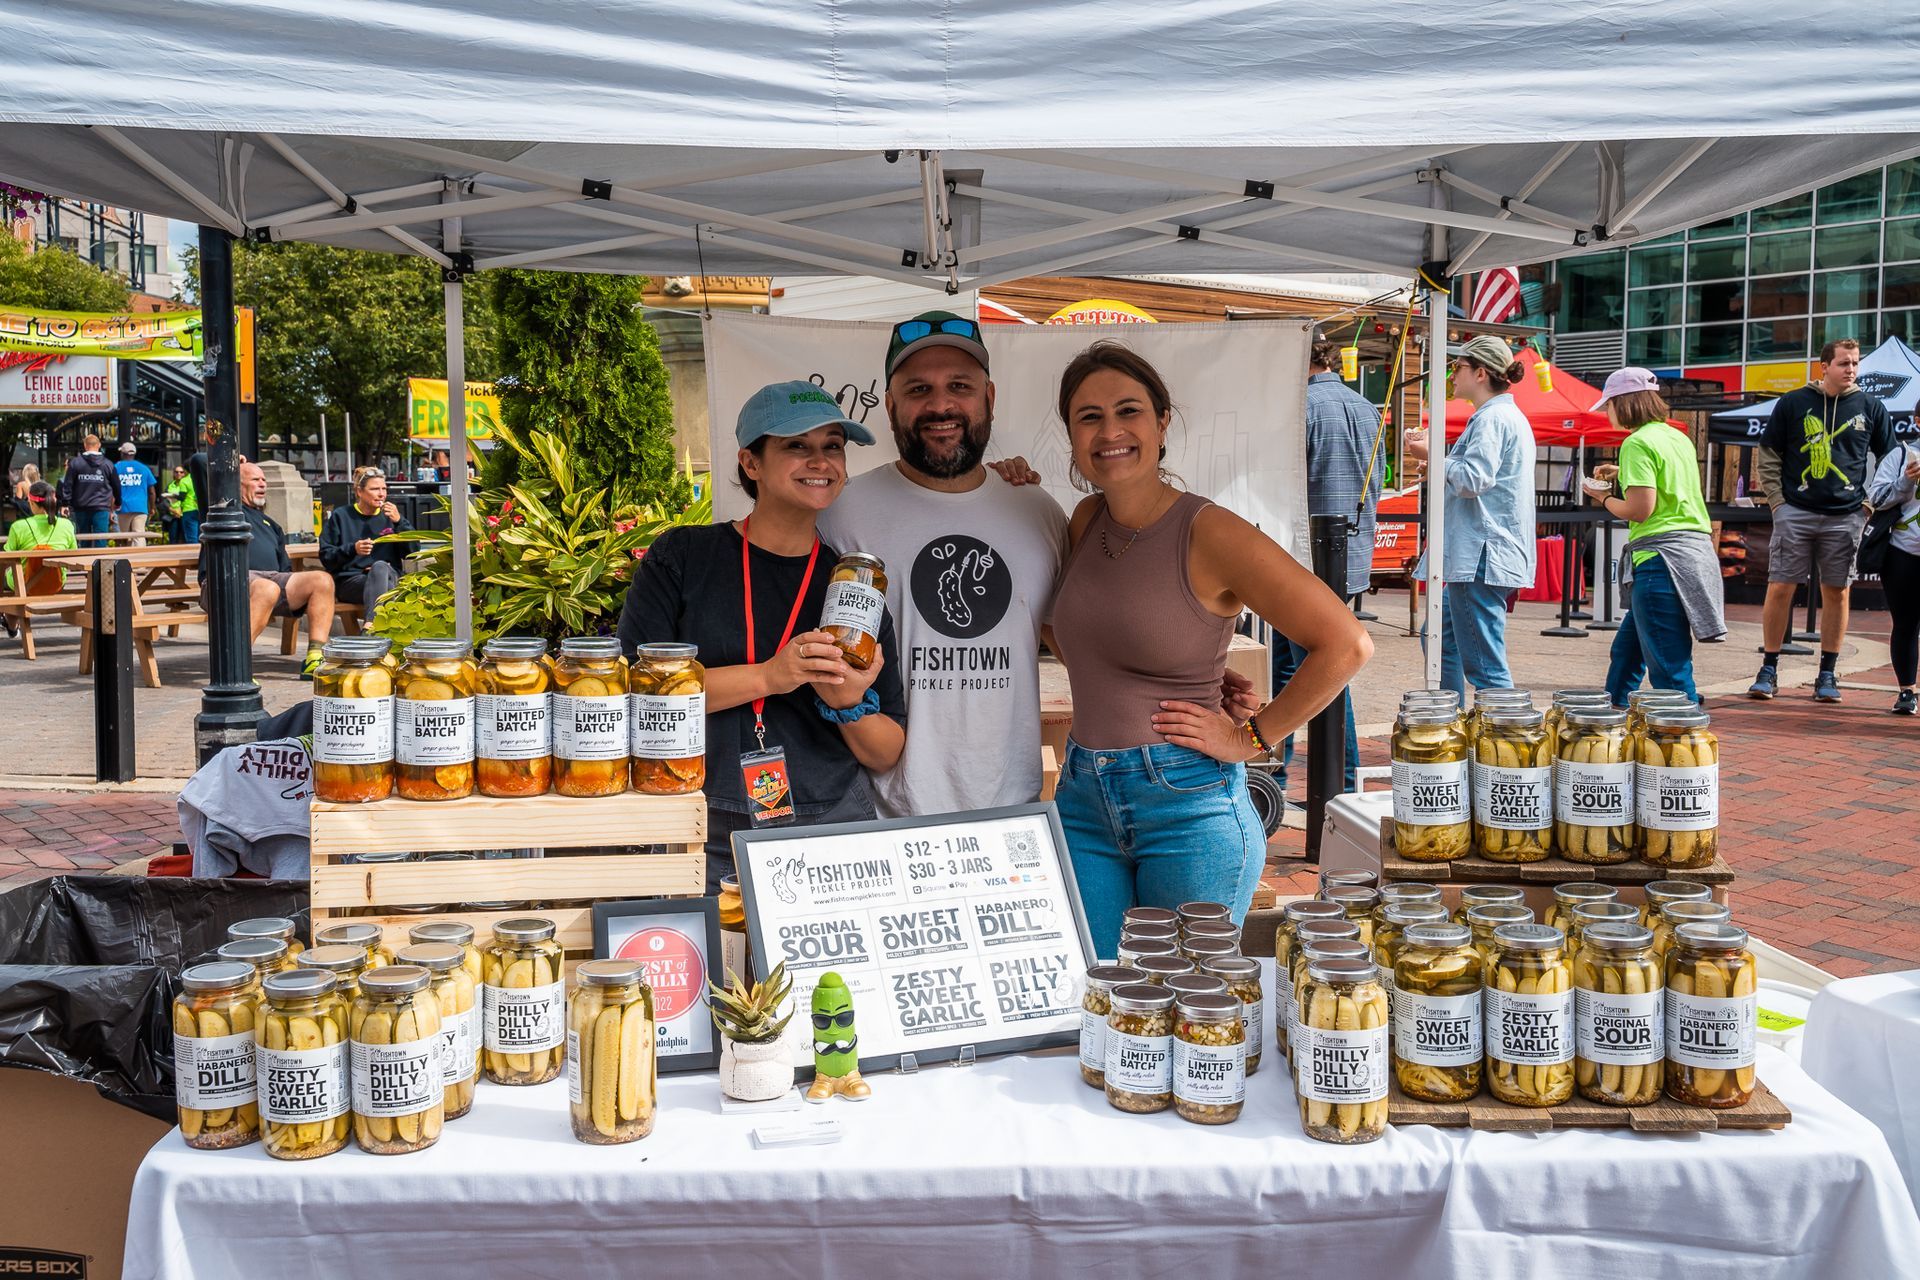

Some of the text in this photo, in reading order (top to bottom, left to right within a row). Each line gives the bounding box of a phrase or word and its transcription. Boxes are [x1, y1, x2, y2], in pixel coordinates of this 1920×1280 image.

[34, 317, 78, 338] TO
[123, 318, 174, 338] DILL
[35, 339, 75, 348] WORLD
[25, 376, 107, 391] LEINIE LODGE
[31, 394, 100, 404] & BEER GARDEN
[412, 399, 490, 436] FRED
[78, 472, 104, 482] mosaic
[1374, 533, 1398, 548] 2767
[838, 600, 868, 612] BATCH
[840, 592, 876, 608] LIMITED
[911, 646, 1010, 671] FISHTOWN
[910, 677, 1010, 690] PICKLE PROJECT
[324, 714, 376, 725] LIMITED
[415, 715, 465, 727] LIMITED
[496, 710, 545, 721] LIMITED
[575, 711, 623, 723] LIMITED
[638, 711, 686, 722] LIMITED
[324, 725, 365, 736] BATCH
[415, 727, 456, 737] BATCH
[496, 721, 536, 732] BATCH
[575, 722, 615, 733] BATCH
[638, 721, 676, 732] BATCH
[239, 747, 304, 767] DILLY
[237, 760, 310, 781] PHILLY
[1412, 783, 1460, 797] SWEET
[1491, 783, 1535, 795] ZESTY
[1572, 784, 1620, 794] ORIGINAL
[1660, 787, 1708, 796] HABANERO
[1413, 795, 1459, 807] ONION
[1490, 794, 1540, 806] SWEET
[1572, 793, 1622, 808] SOUR
[1660, 796, 1702, 811] DILL
[754, 806, 793, 821] VENDOR
[1490, 806, 1539, 818] GARLIC
[904, 840, 932, 859] $12
[944, 838, 953, 854] 1
[956, 836, 980, 853] JAR
[807, 859, 893, 885] FISHTOWN
[908, 861, 936, 880] $30
[949, 859, 958, 875] 3
[961, 856, 993, 874] JARS
[1014, 861, 1041, 869] venmo
[810, 877, 893, 894] PICKLE PROJECT
[955, 881, 968, 889] Pay
[984, 877, 1008, 887] VISA
[813, 890, 896, 905] www.fishtownpickles.com
[975, 898, 1048, 915] HABANERO
[879, 907, 959, 933] SWEET
[977, 911, 1042, 937] DILL
[778, 919, 861, 939] ORIGINAL
[883, 925, 962, 950] ONION
[781, 932, 867, 962] SOUR
[643, 959, 688, 975] EST of
[989, 954, 1069, 979] PHILLY
[891, 966, 963, 992] ZESTY
[993, 973, 1058, 997] DILLY
[655, 996, 672, 1011] 022
[895, 983, 977, 1010] SWEET
[997, 991, 1050, 1014] DELI
[498, 1002, 550, 1017] PHILLY
[900, 1000, 984, 1028] GARLIC
[1689, 1009, 1716, 1017] FISHTOWN
[498, 1015, 541, 1027] DILLY
[1416, 1019, 1471, 1033] SWEET
[1502, 1012, 1553, 1026] ZESTY
[1593, 1017, 1649, 1028] ORIGINAL
[1679, 1017, 1735, 1031] HABANERO
[499, 1028, 531, 1039] DELI
[1416, 1032, 1469, 1045] ONION
[1502, 1025, 1559, 1039] SWEET
[1594, 1028, 1651, 1044] SOUR
[1680, 1030, 1727, 1047] DILL
[1502, 1038, 1559, 1051] GARLIC
[1121, 1049, 1165, 1062] LIMITED
[1313, 1047, 1369, 1062] PHILLY
[196, 1056, 253, 1071] HABANERO
[370, 1057, 428, 1076] PHILLY
[1120, 1060, 1156, 1070] BATCH
[1188, 1060, 1233, 1072] LIMITED
[1313, 1060, 1359, 1075] DILLY
[198, 1068, 246, 1087] DILL
[268, 1068, 320, 1083] ZESTY
[370, 1073, 419, 1089] DILLY
[1188, 1069, 1224, 1081] BATCH
[1314, 1073, 1348, 1088] DELI
[268, 1080, 326, 1096] SWEET
[371, 1087, 409, 1101] DELI
[269, 1093, 328, 1109] GARLIC
[36, 1261, 80, 1274] BOX
